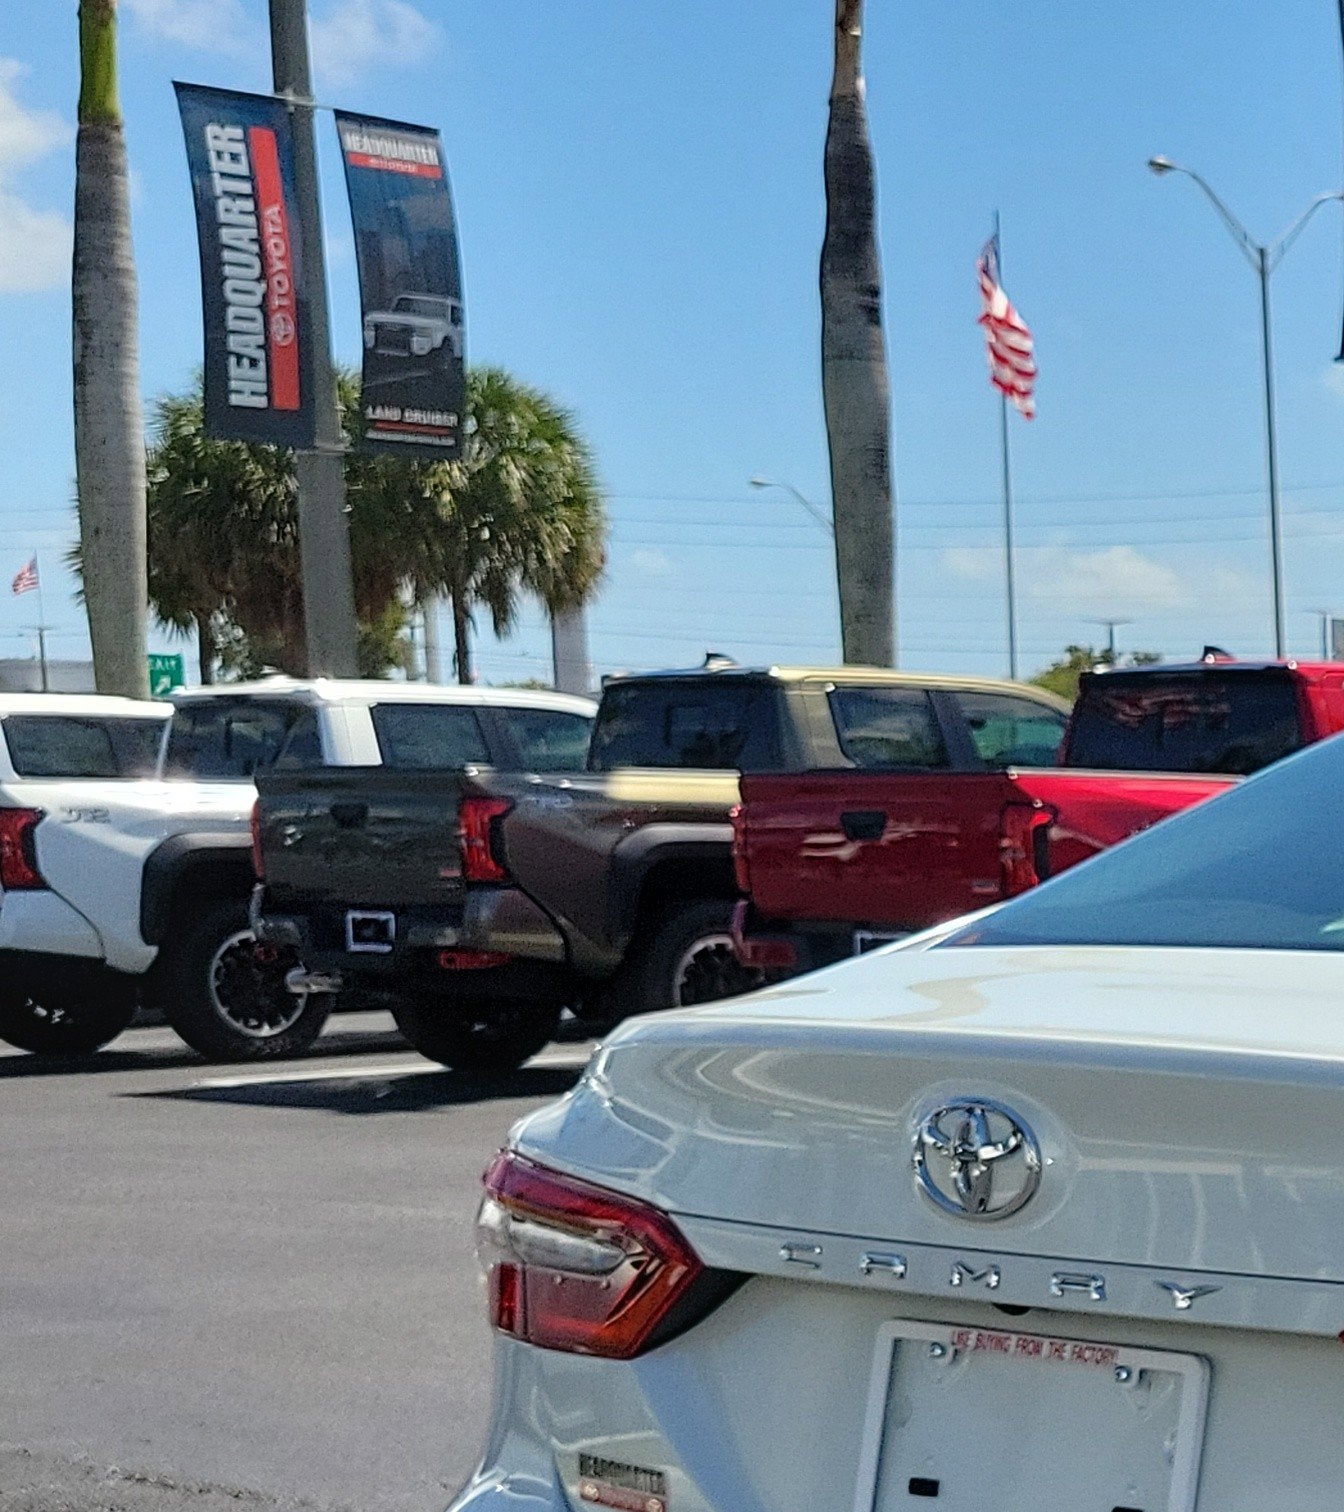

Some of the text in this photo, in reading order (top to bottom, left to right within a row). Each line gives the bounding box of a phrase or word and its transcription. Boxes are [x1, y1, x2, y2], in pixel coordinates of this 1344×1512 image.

[205, 122, 268, 409] HEADQUARTER
[266, 205, 292, 308] TOYOTA
[780, 1241, 1222, 1309] CAMRY
